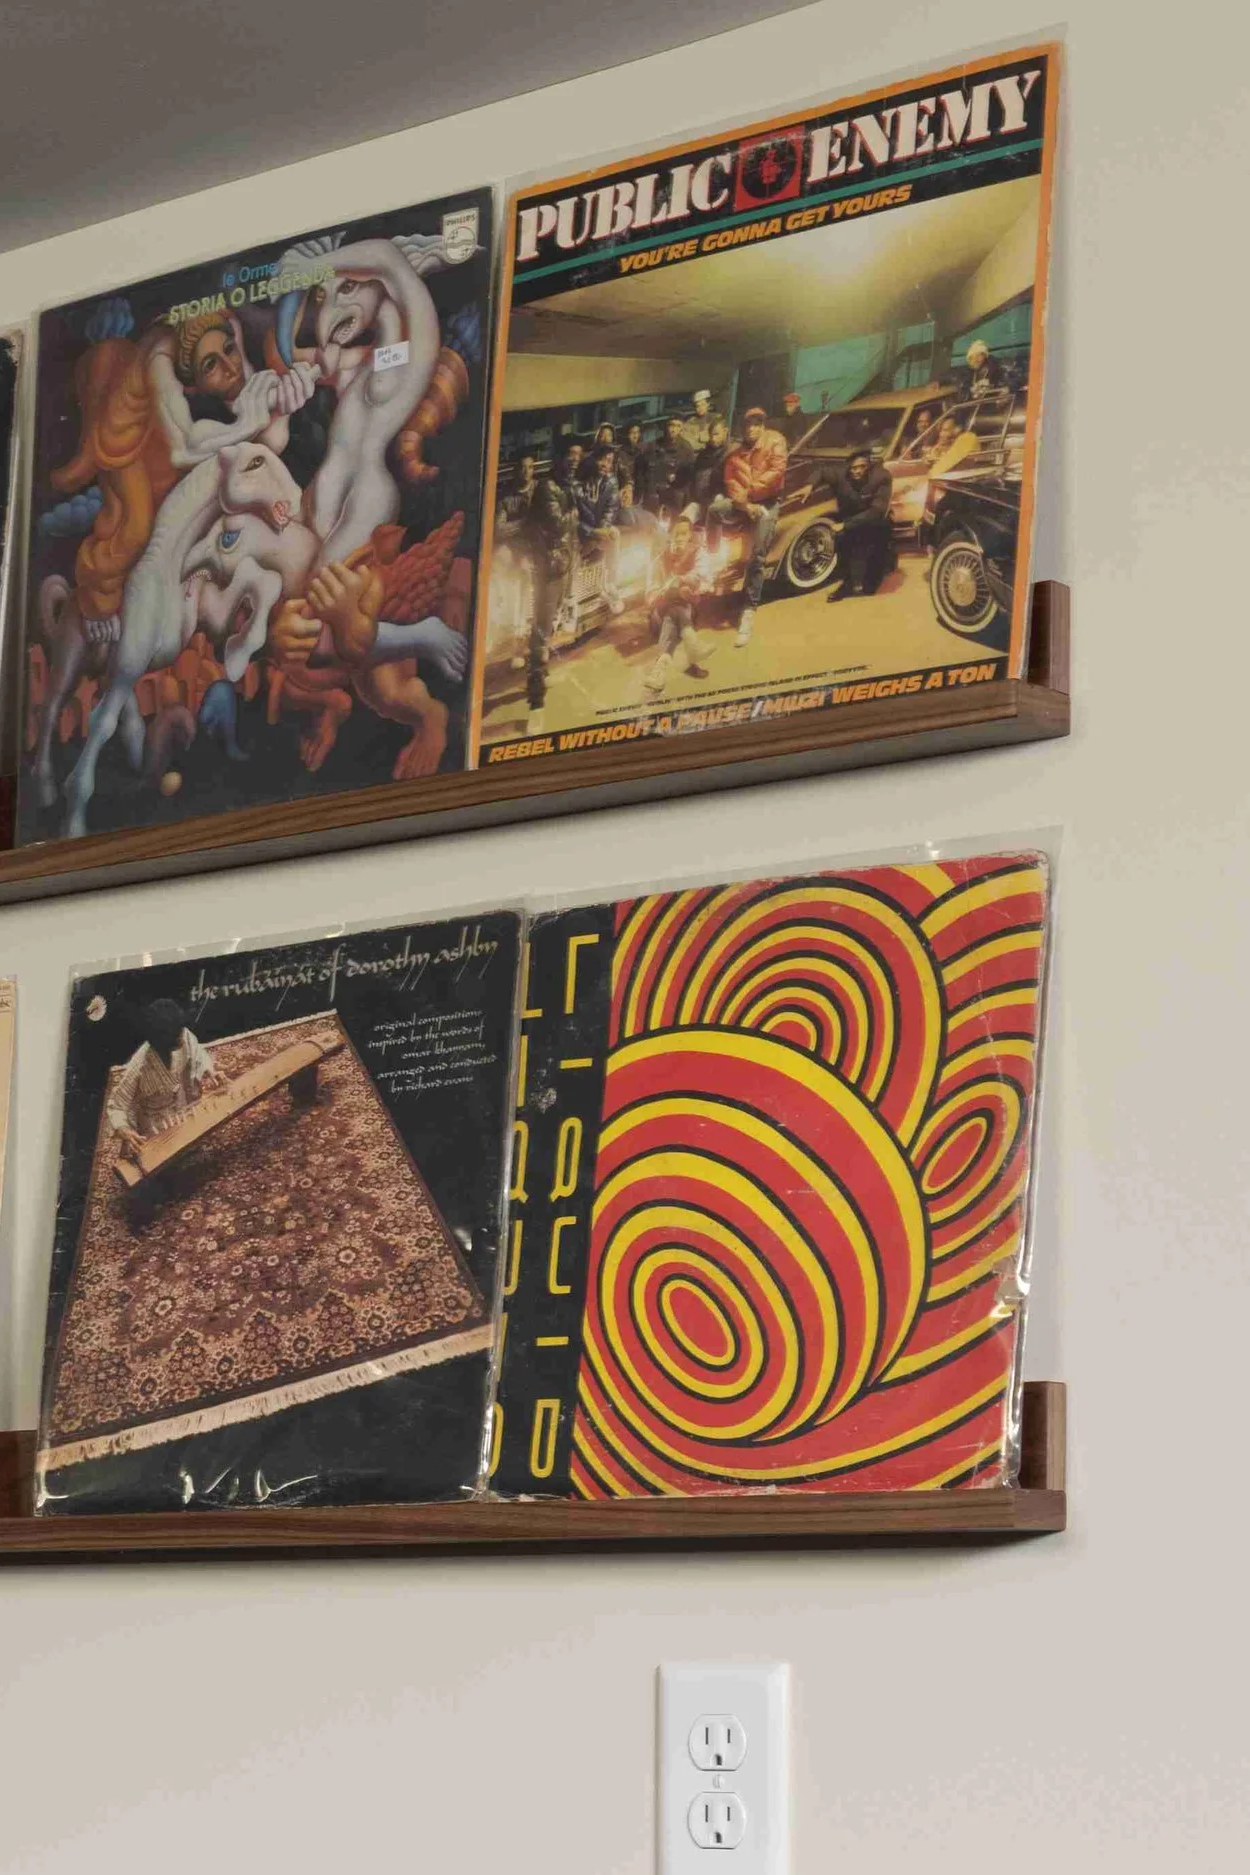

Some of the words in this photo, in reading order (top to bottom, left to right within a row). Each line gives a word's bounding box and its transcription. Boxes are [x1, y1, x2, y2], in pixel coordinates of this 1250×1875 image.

[516, 151, 729, 262] PUBLIC
[805, 69, 1041, 183] ENEMY
[446, 213, 477, 227] PHILIPS
[619, 236, 699, 274] YOU'RE
[702, 222, 783, 255] GONNA
[786, 206, 828, 231] GET
[829, 183, 913, 223] YOURS
[168, 293, 226, 324] STORIA
[231, 287, 247, 308] O
[250, 264, 337, 303] LEGGENDA
[488, 738, 555, 763] REBEL
[559, 719, 656, 751] WITHOUT
[830, 676, 920, 706] WEIGHS
[926, 671, 943, 689] A
[947, 663, 996, 686] TON
[190, 969, 217, 1016] the
[318, 942, 347, 1002] of
[347, 935, 429, 988] dorothy
[434, 924, 499, 980] ashby
[367, 1036, 407, 1056] inspired
[410, 1029, 422, 1048] by
[425, 1026, 438, 1042] the
[441, 1024, 472, 1037] words
[473, 1016, 485, 1040] of
[373, 1012, 416, 1037] original
[417, 1009, 482, 1030] compositions
[377, 1066, 426, 1083] arranged
[427, 1062, 448, 1073] and
[449, 1054, 498, 1070] conducted
[401, 1049, 432, 1060] omar
[405, 1076, 442, 1094] richard
